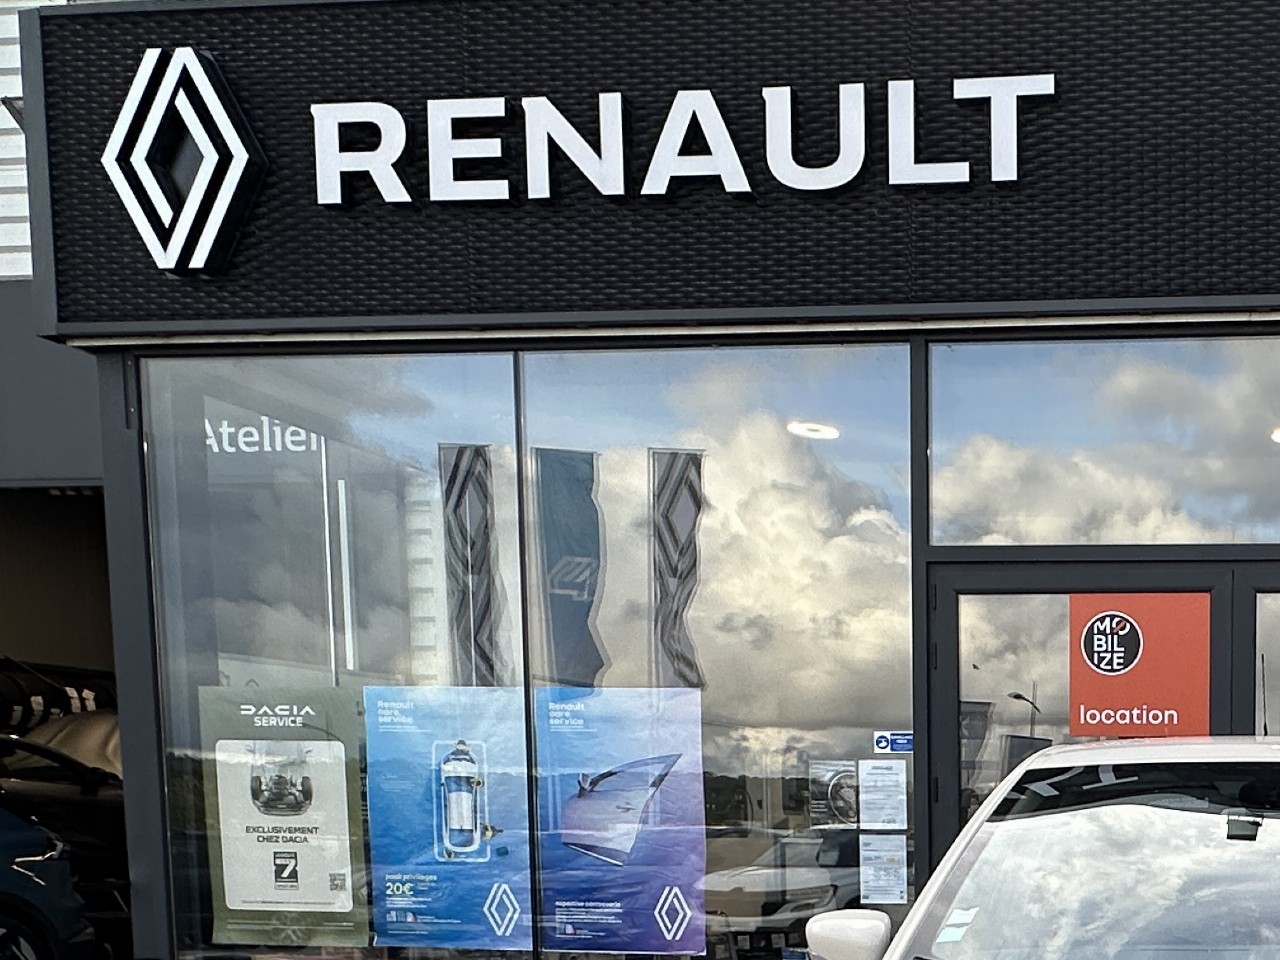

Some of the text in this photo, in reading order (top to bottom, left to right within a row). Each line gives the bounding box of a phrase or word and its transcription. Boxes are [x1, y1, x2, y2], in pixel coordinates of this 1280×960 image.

[310, 73, 1056, 205] RENAULT
[240, 704, 316, 716] DACIA
[548, 702, 585, 711] Renault
[1079, 704, 1178, 725] location
[254, 716, 303, 727] SERVICE
[245, 825, 319, 835] EXCLUSIVEMENT
[256, 835, 309, 844] CHEZ DACIA
[385, 882, 415, 895] 20€
